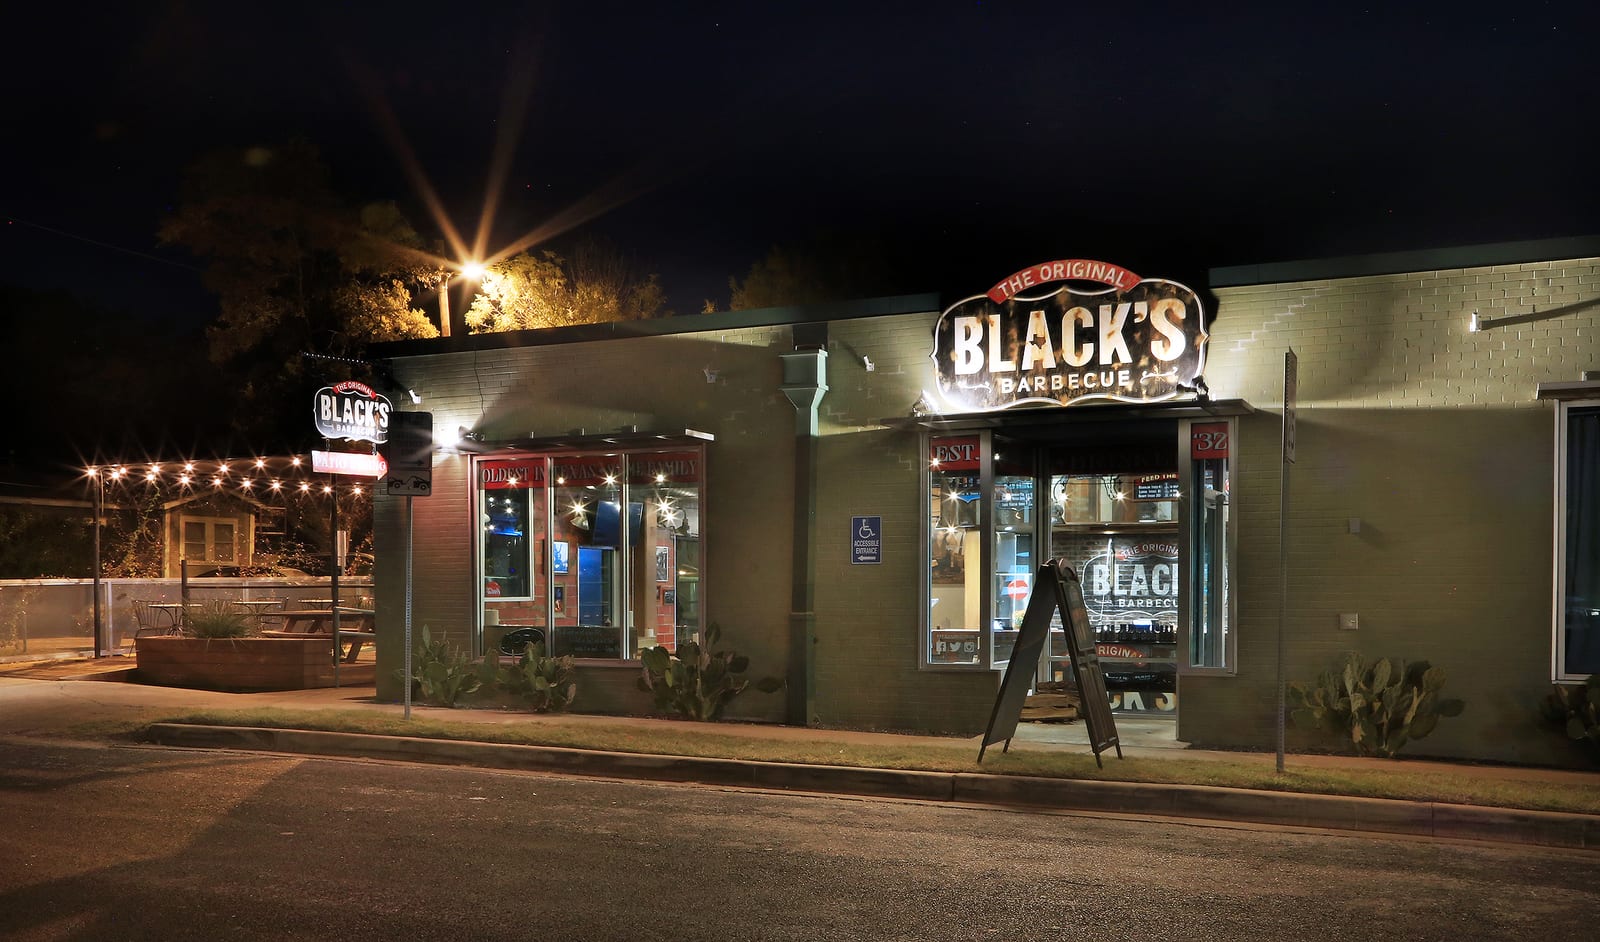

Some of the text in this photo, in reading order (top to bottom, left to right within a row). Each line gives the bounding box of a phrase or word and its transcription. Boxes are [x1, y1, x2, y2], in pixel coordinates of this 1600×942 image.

[998, 262, 1126, 299] THE ORIGINAL
[954, 298, 1187, 376] BLACK'S
[336, 381, 373, 396] THE ORIGINAL
[1000, 369, 1131, 394] BARBECUE
[320, 394, 389, 428] BLACK'S
[936, 444, 980, 462] EST.
[482, 465, 530, 482] OLDEST
[1121, 546, 1140, 558] THE
